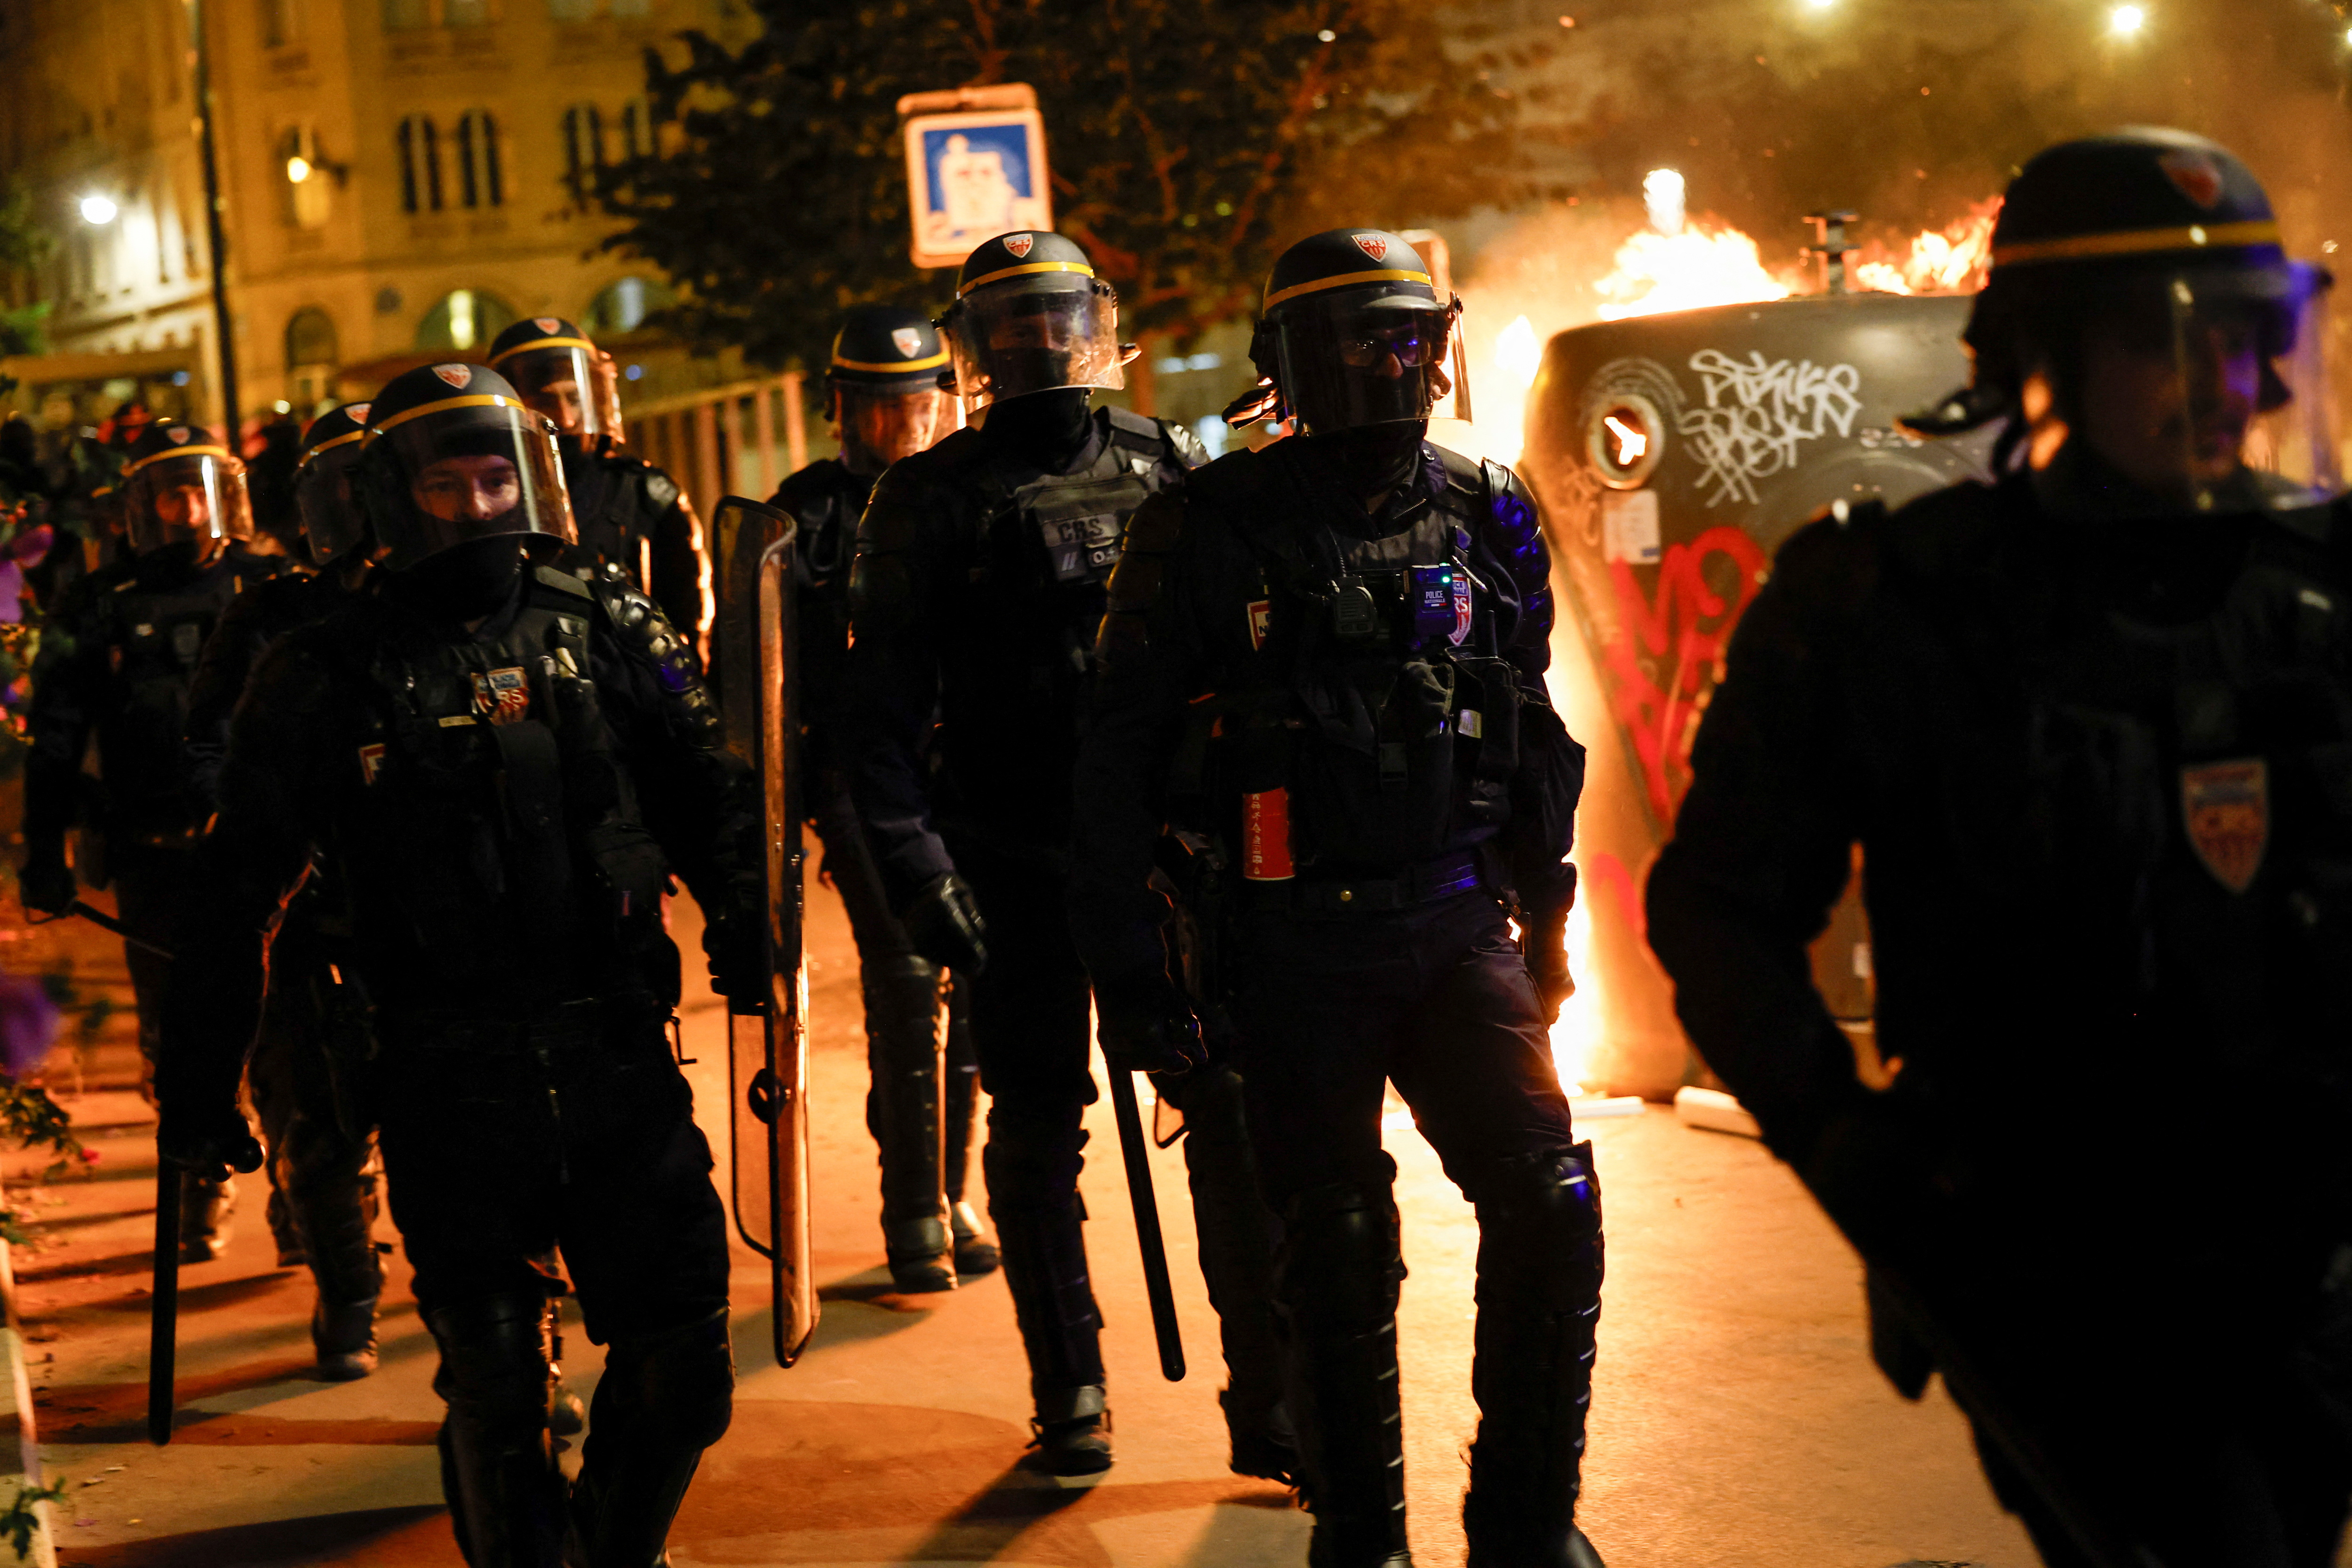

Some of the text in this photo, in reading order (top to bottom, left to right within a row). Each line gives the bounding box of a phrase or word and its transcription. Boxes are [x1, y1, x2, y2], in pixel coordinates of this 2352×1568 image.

[1058, 518, 1102, 541] CRS
[1425, 590, 1444, 599] POLICE
[1454, 597, 1468, 613] RS
